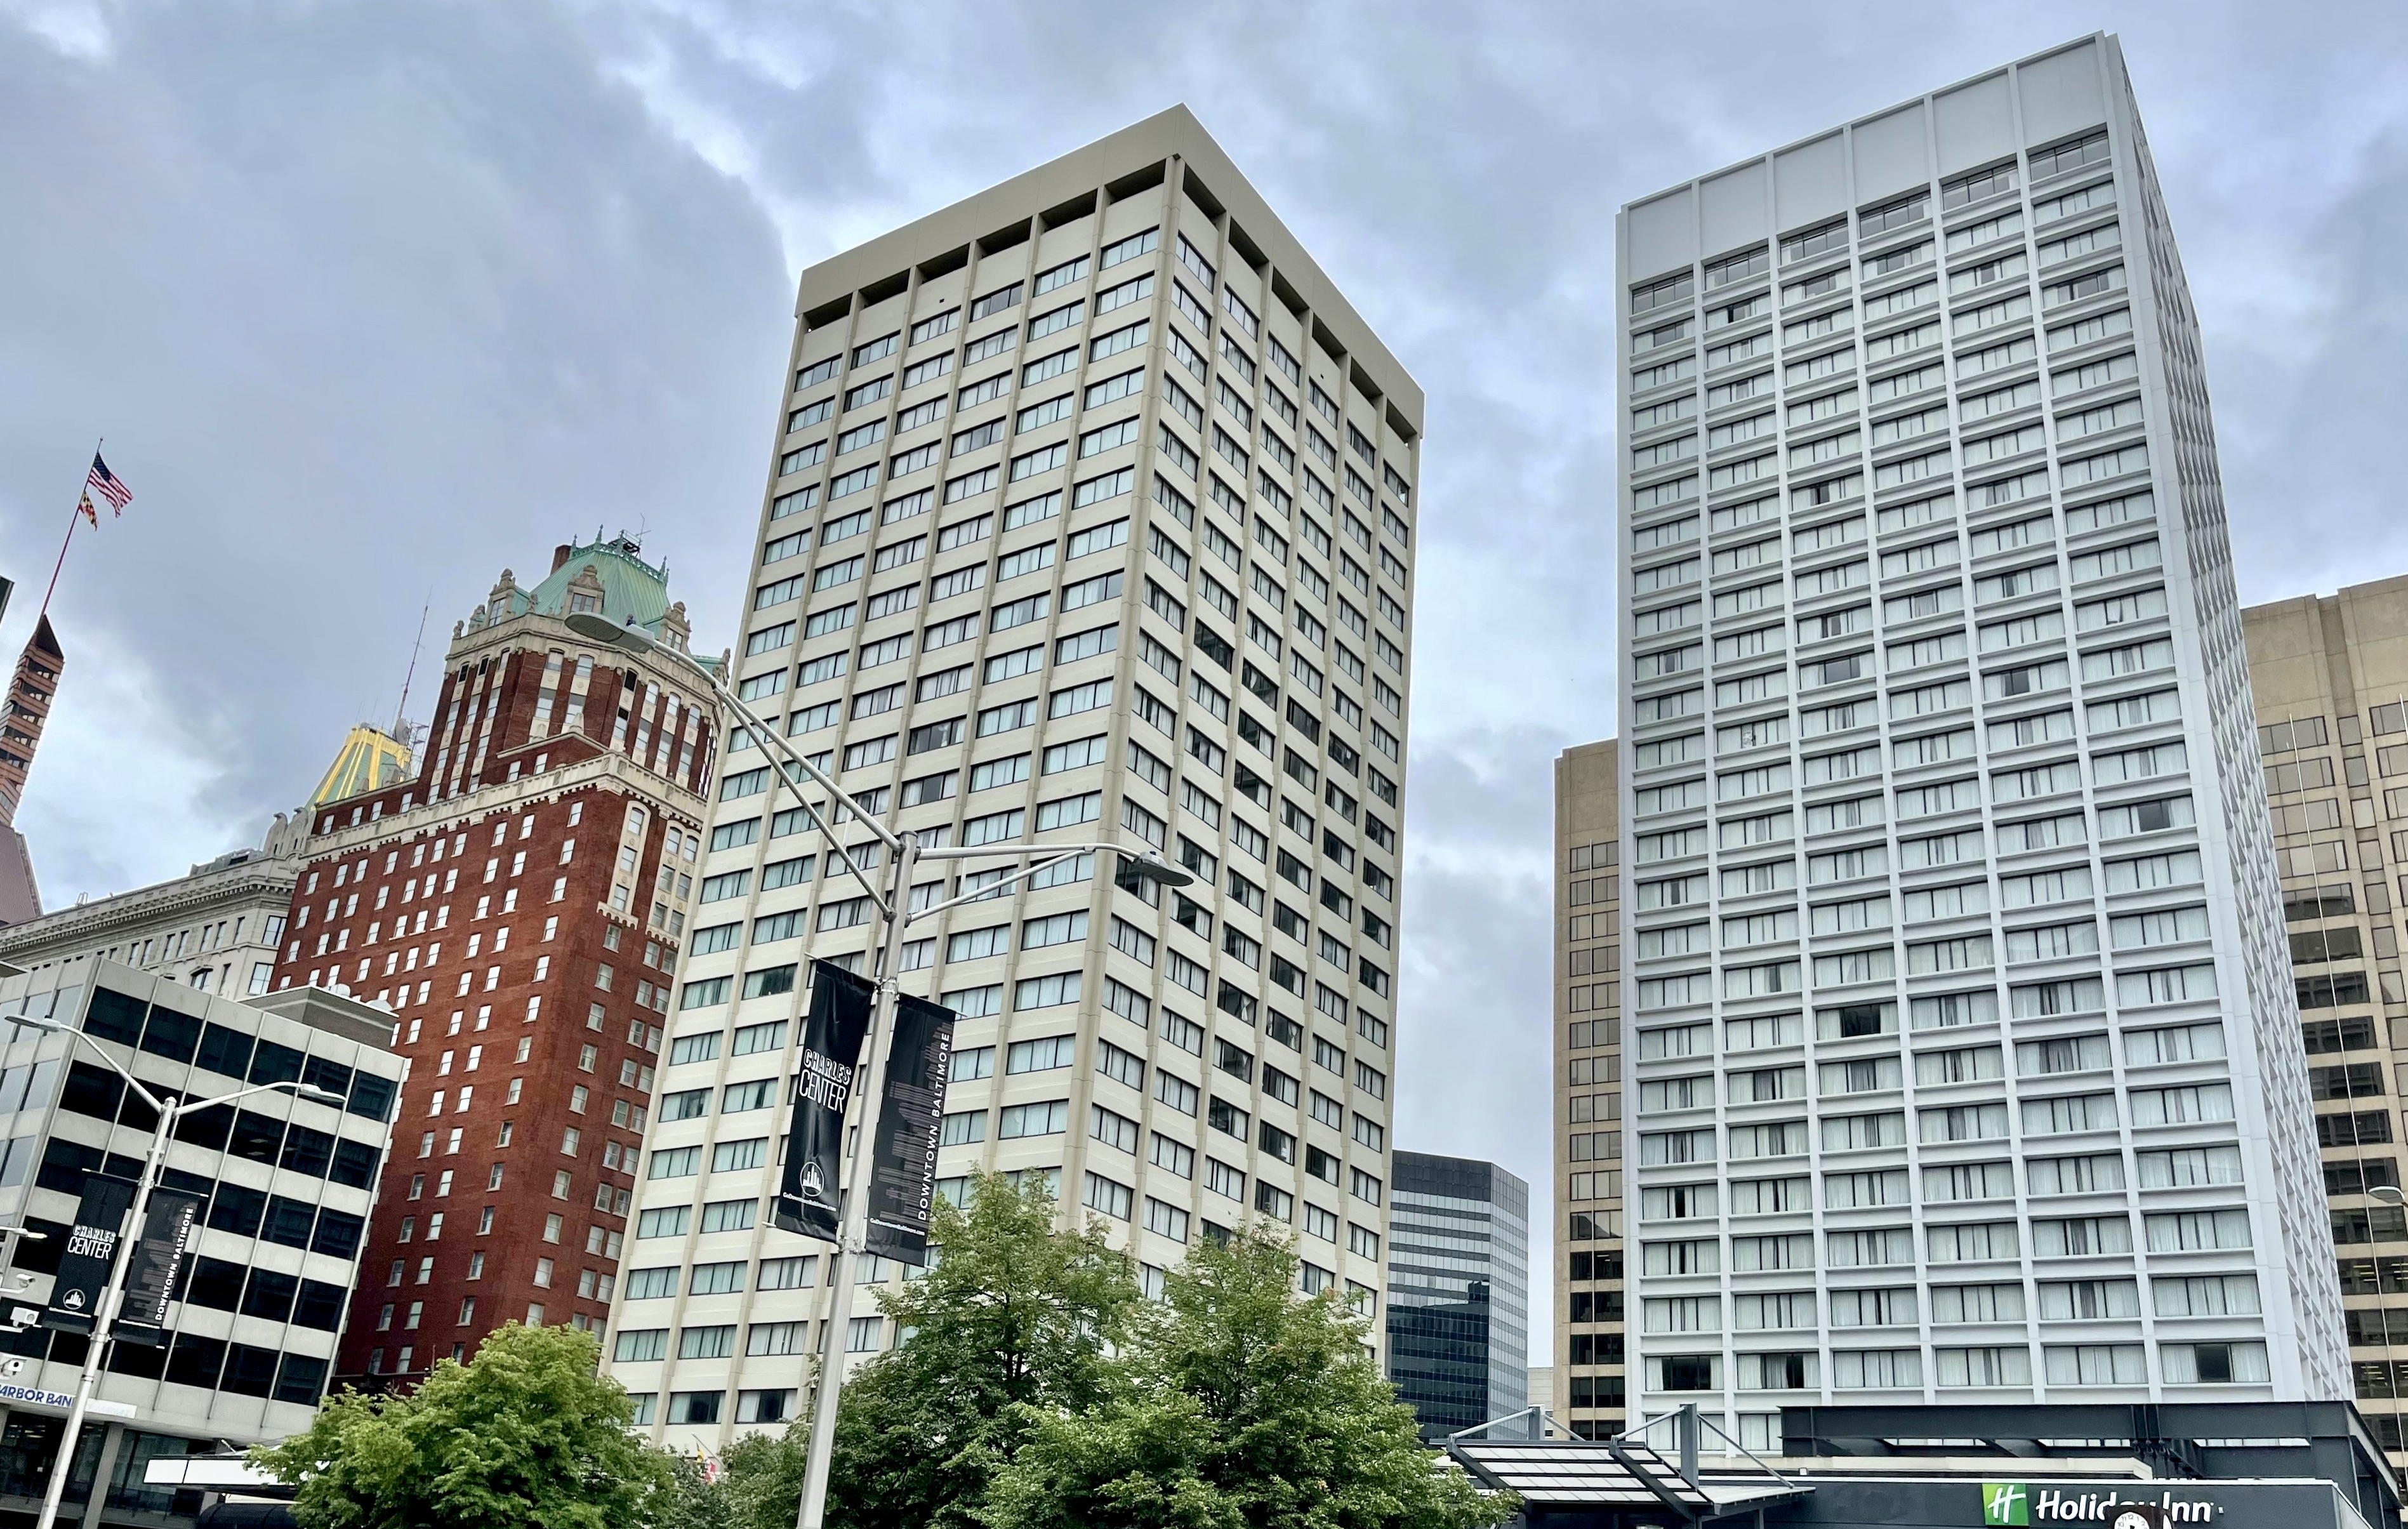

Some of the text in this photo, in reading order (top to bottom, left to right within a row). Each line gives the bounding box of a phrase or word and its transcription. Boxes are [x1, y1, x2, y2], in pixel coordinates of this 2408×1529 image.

[804, 1049, 851, 1085] CHARLES
[799, 1069, 846, 1113] CENTER
[918, 1032, 949, 1221] DOWNTOWN BALTIMORE
[67, 1236, 112, 1260] CENTER
[73, 1224, 116, 1243] CHARLES
[155, 1208, 194, 1320] DOWNTOWN BALTIMORE
[0, 1384, 74, 1408] ARBOR BAN
[2035, 1490, 2212, 1522] Holid Inn
